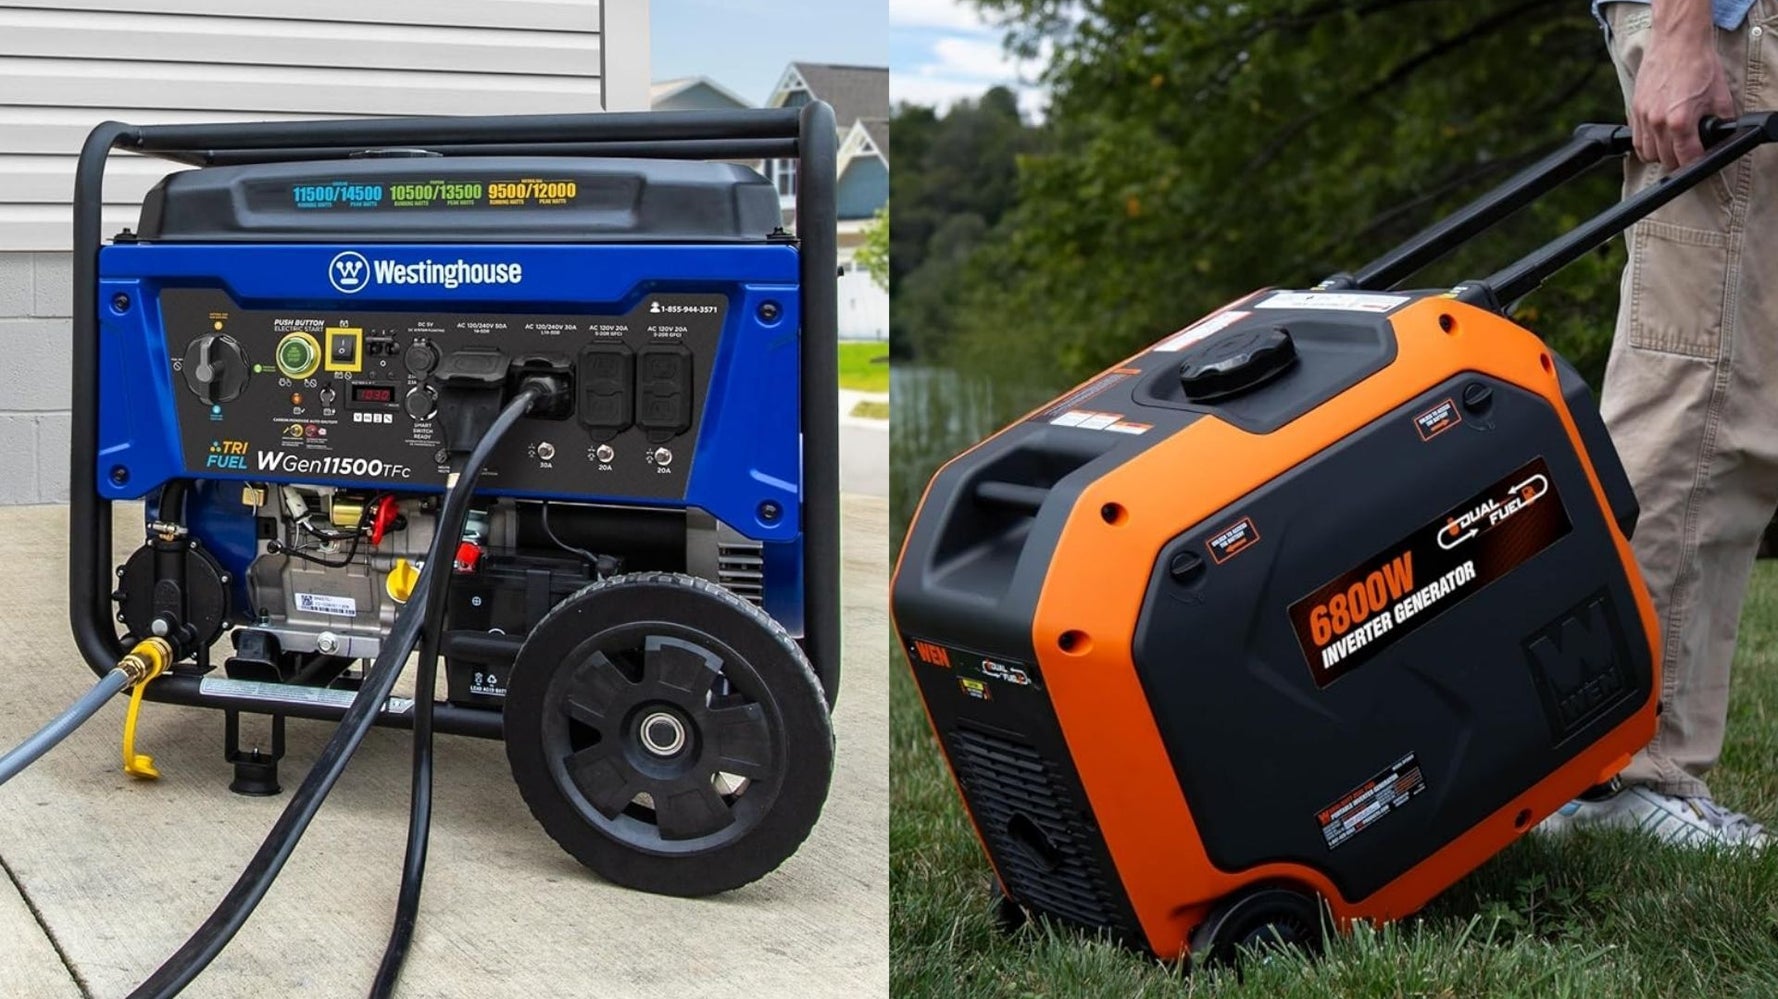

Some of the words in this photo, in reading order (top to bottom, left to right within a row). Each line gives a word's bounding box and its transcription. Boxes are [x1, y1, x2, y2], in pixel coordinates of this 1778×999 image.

[293, 186, 382, 202] 11500/14500
[389, 184, 482, 201] 10500/13500
[488, 182, 576, 199] 9500/12000
[374, 259, 522, 289] Westinghouse
[661, 305, 718, 314] 1-855-944-3571
[222, 441, 249, 455] TRI
[206, 455, 248, 470] FUEL
[1460, 499, 1500, 529] DUAL
[1489, 497, 1524, 526] FUEL
[1310, 550, 1414, 647] 6800W
[1322, 611, 1394, 670] INVERTER
[1394, 560, 1477, 624] GENERATOR
[914, 641, 952, 668] WEN
